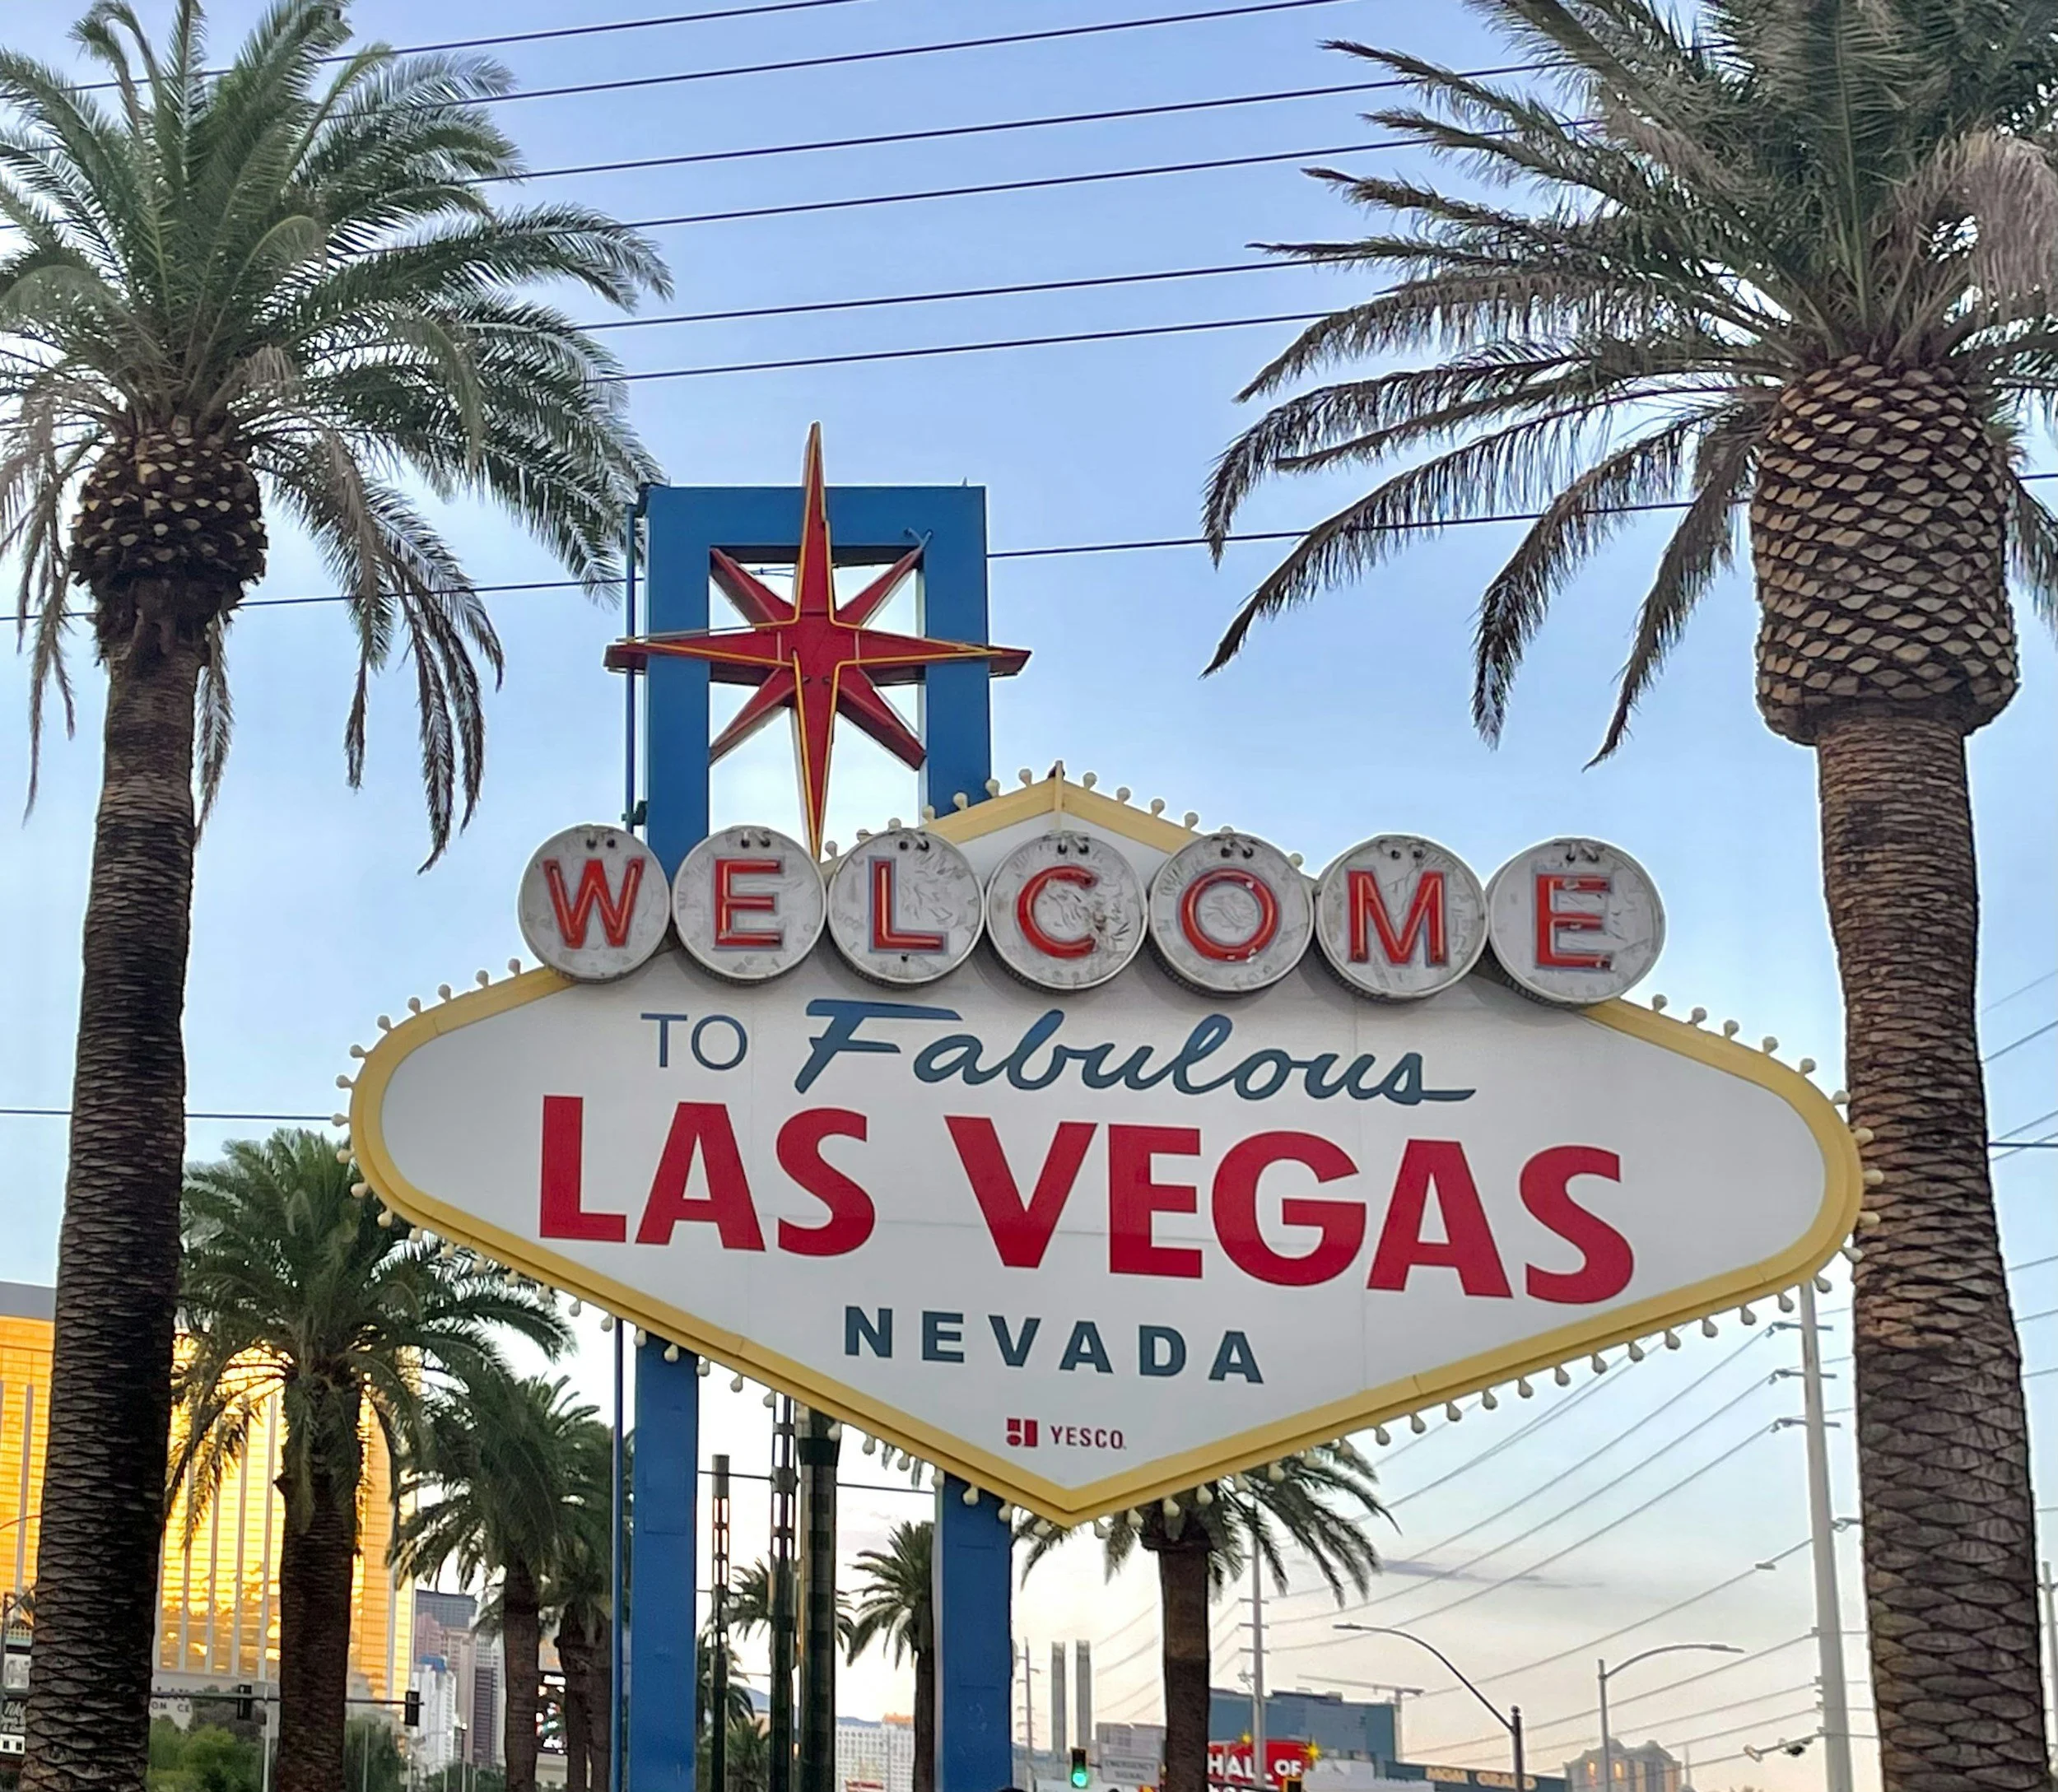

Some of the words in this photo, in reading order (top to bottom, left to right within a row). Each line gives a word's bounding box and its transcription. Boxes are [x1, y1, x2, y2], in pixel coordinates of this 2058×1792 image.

[542, 856, 1616, 972] WELCOME
[640, 1012, 748, 1071] TO
[793, 998, 1477, 1105] Fabulous
[539, 1095, 876, 1257] LAS
[943, 1115, 1634, 1305] VEGAS
[843, 1304, 1264, 1385] NEVADA
[1050, 1425, 1125, 1450] YESCO
[1208, 1752, 1274, 1781] HAL
[1273, 1758, 1302, 1776] OF
